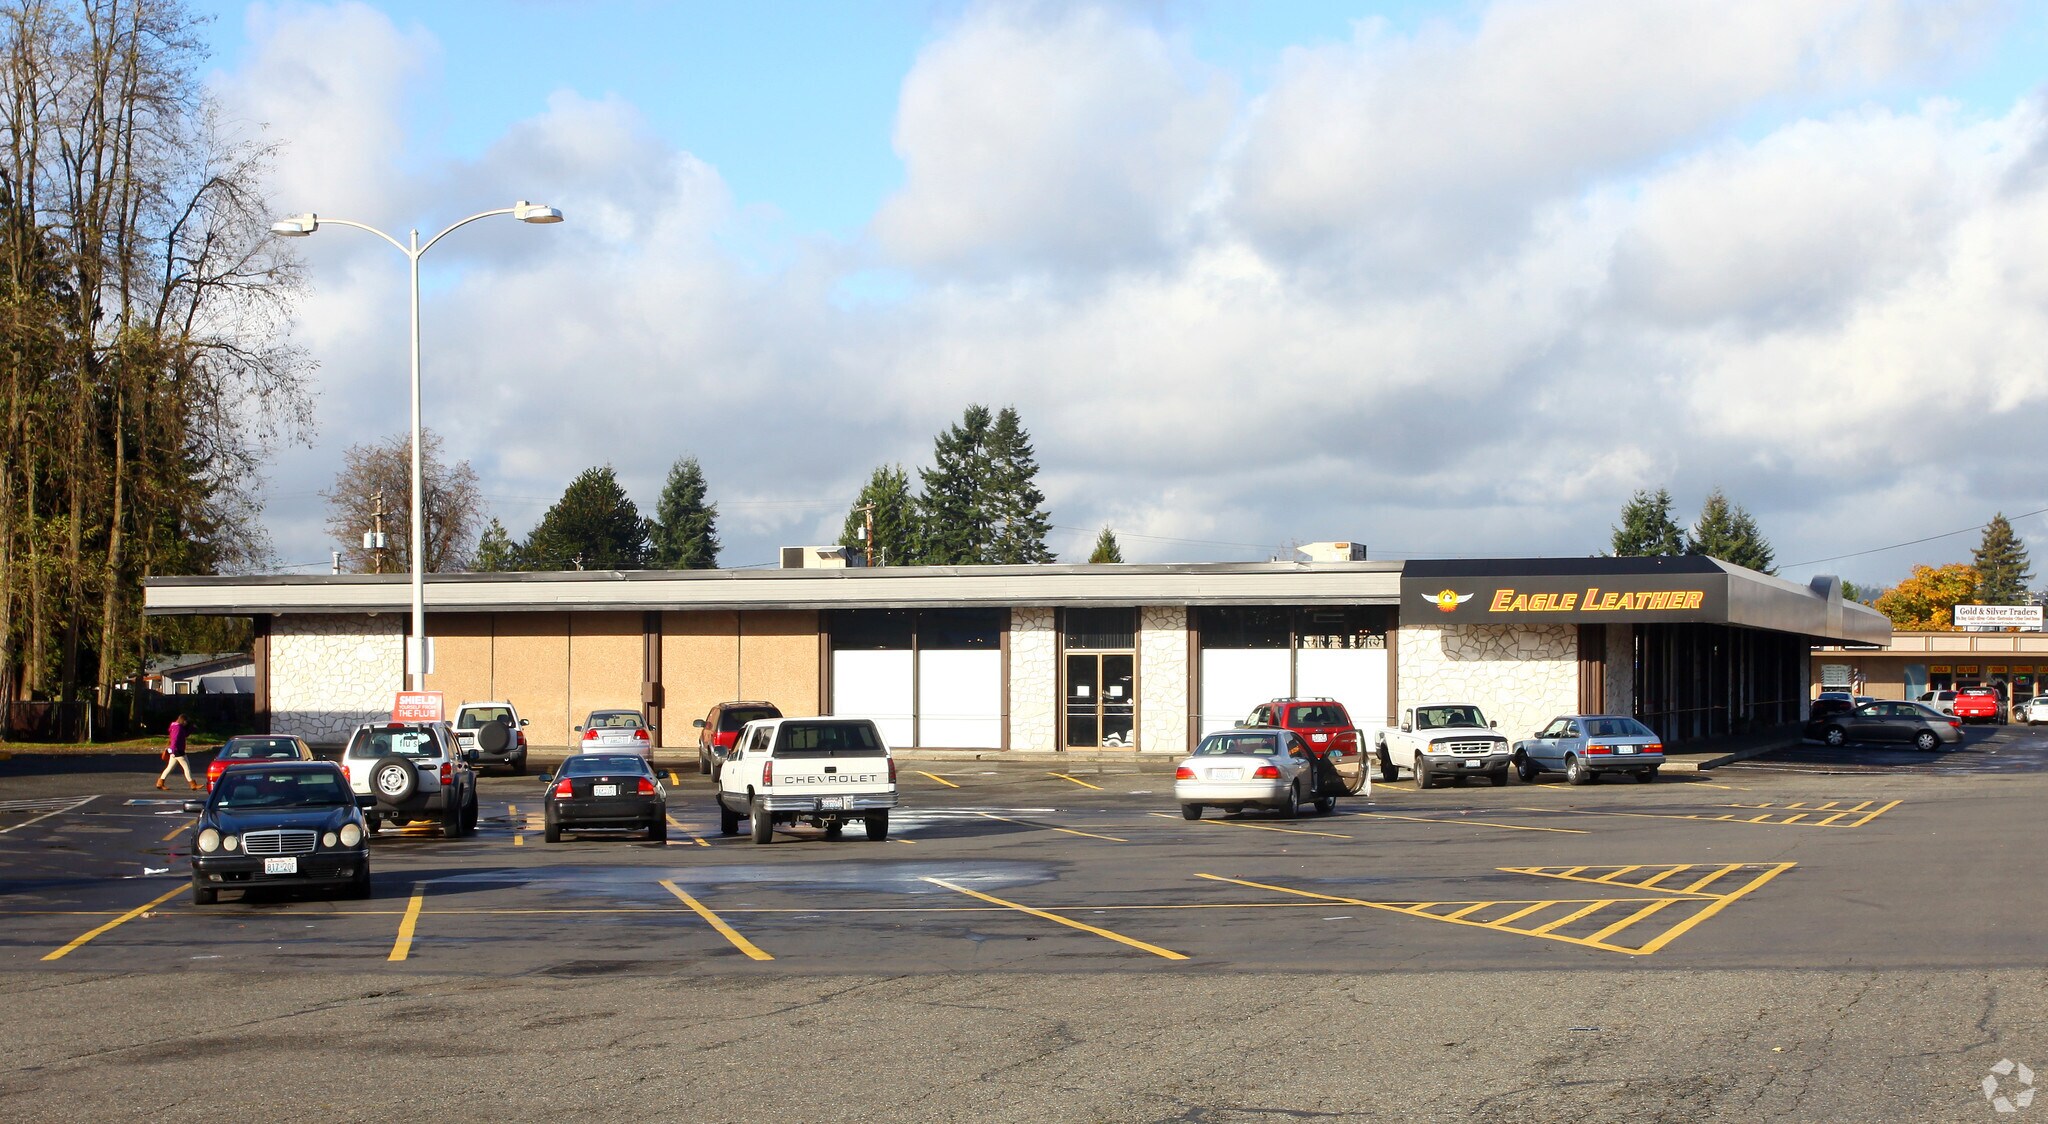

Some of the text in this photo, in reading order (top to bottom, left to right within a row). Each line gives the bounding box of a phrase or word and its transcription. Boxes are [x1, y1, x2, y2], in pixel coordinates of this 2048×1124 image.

[1489, 588, 1703, 612] EAGLE LEATHER
[1959, 607, 2038, 616] Gold & Silver Traders
[399, 695, 436, 705] SHIELD
[398, 709, 413, 717] THE
[413, 709, 429, 717] FLU
[784, 774, 877, 784] CHEVROLET
